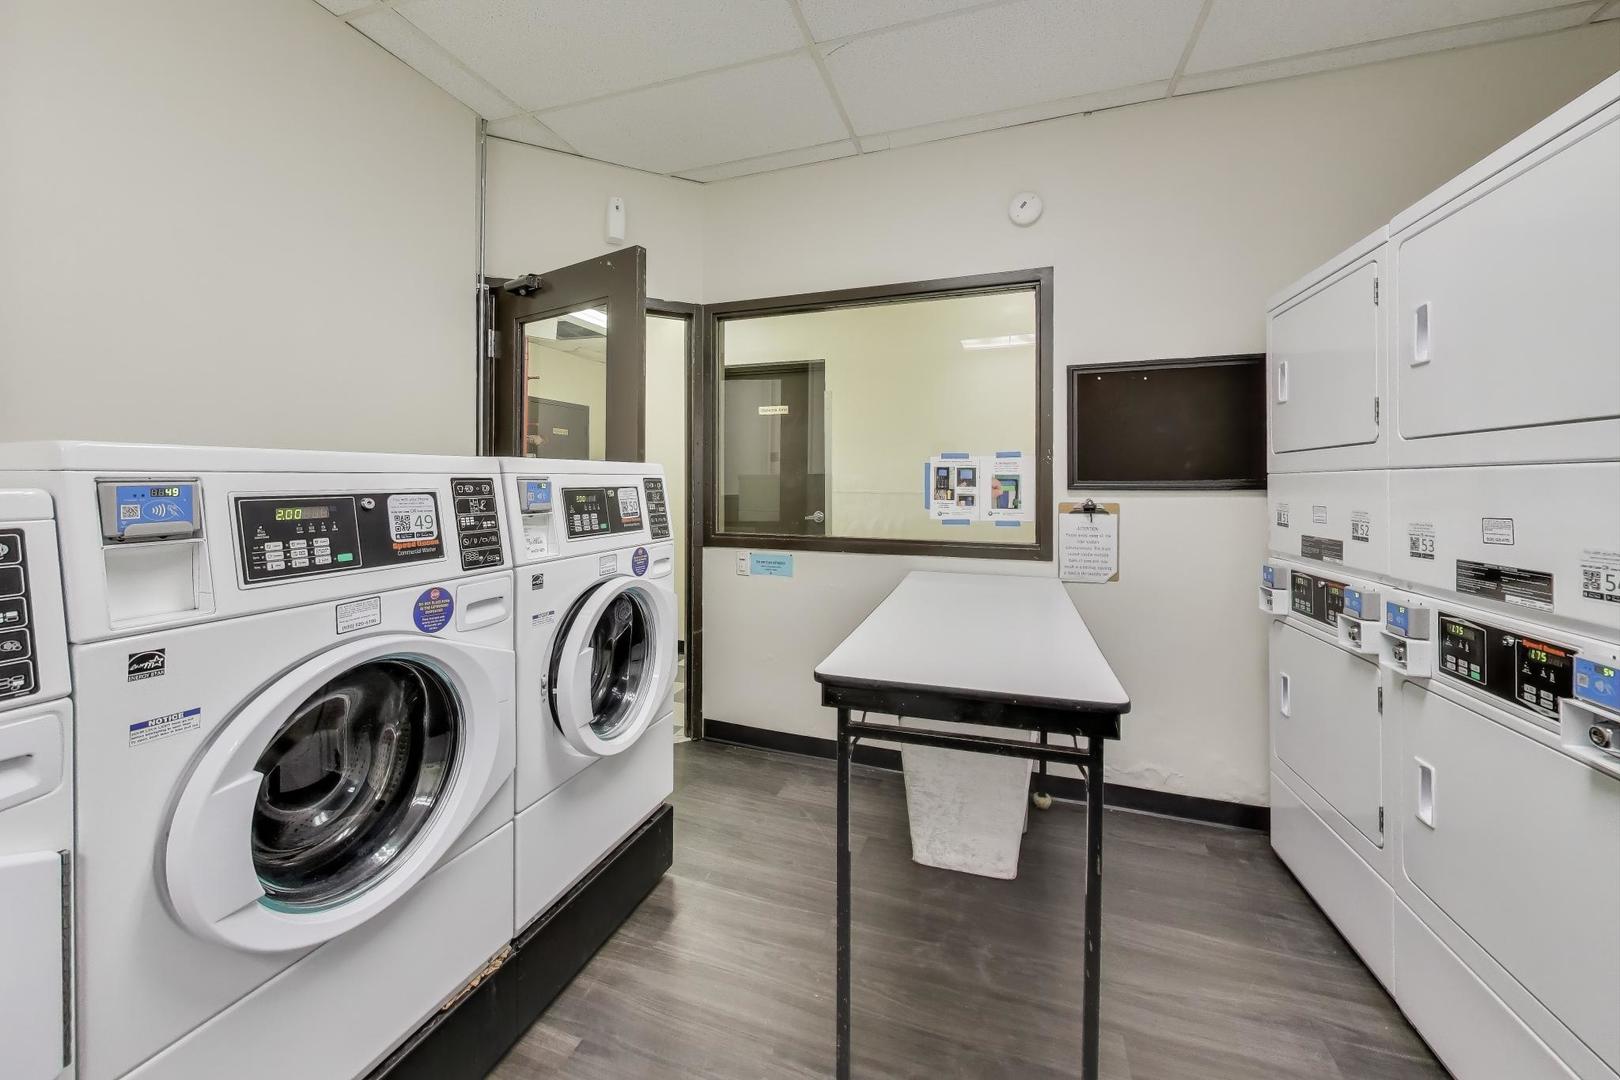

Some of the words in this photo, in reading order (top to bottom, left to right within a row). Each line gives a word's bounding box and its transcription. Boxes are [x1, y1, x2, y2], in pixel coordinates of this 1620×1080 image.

[165, 487, 179, 496] 49
[276, 508, 302, 520] 2.00
[414, 514, 434, 530] 49
[1360, 524, 1370, 536] 52
[1421, 538, 1434, 552] 53
[128, 673, 149, 681] ENERGY
[148, 712, 184, 726] NOTICE
